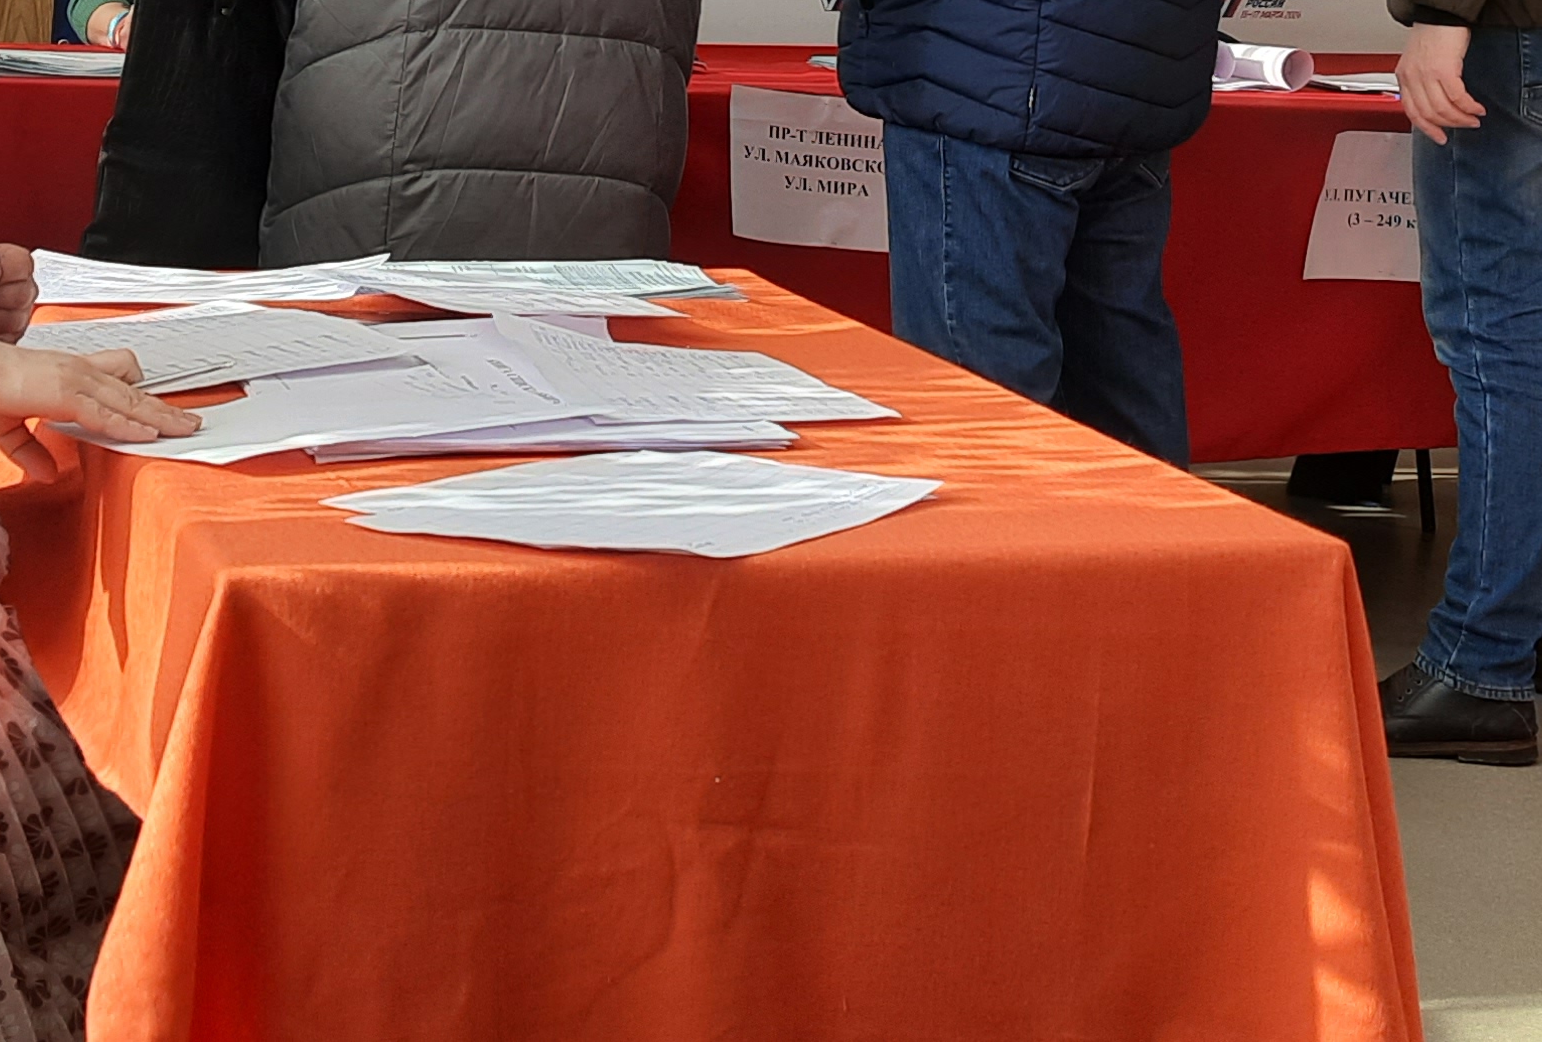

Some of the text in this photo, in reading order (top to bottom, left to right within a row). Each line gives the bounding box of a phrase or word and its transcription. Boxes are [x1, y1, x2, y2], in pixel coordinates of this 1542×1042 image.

[769, 125, 807, 142] ПР-Т
[744, 145, 885, 173] УЛ. МАЯКОВСКО
[784, 176, 869, 197] УЛ. МИРА
[1344, 189, 1414, 204] ПУГАЧЕ
[1348, 213, 1360, 228] (3
[1377, 214, 1401, 226] 249
